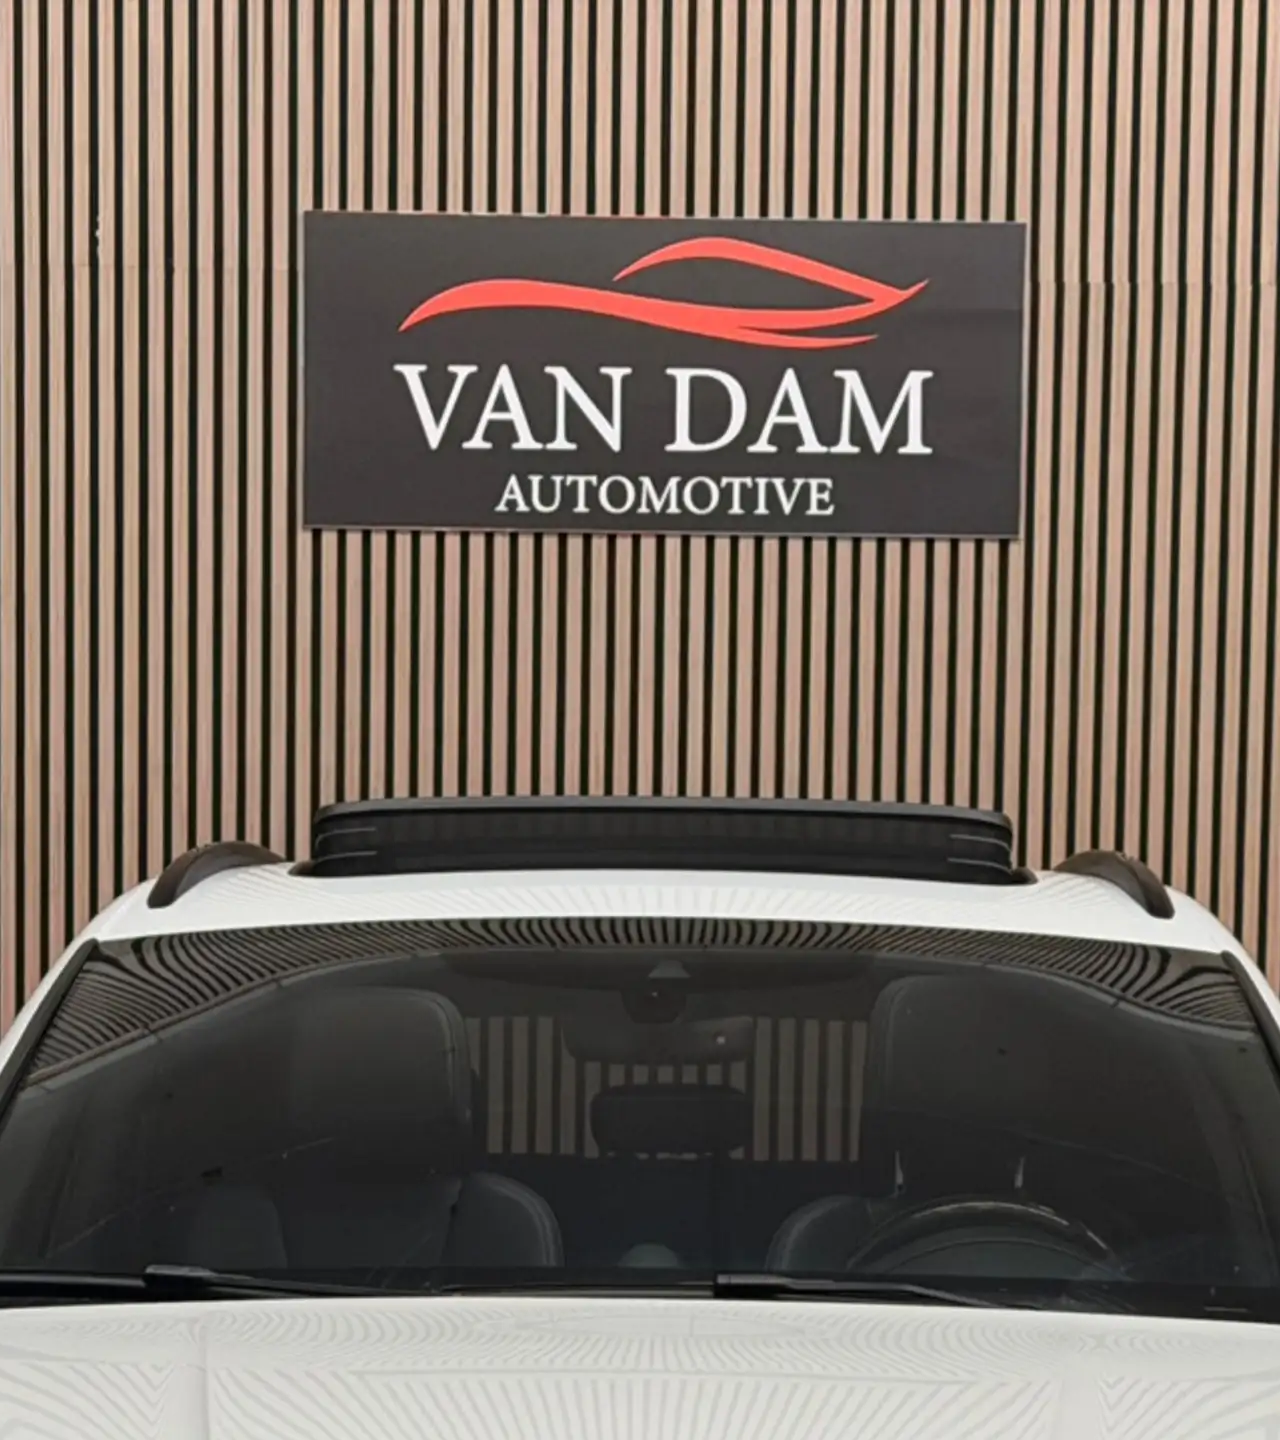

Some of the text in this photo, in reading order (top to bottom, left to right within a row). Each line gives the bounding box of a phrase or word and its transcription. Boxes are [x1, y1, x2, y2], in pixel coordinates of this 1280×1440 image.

[393, 363, 934, 455] VAN DAM
[494, 473, 836, 516] AUTOMOTIVE
